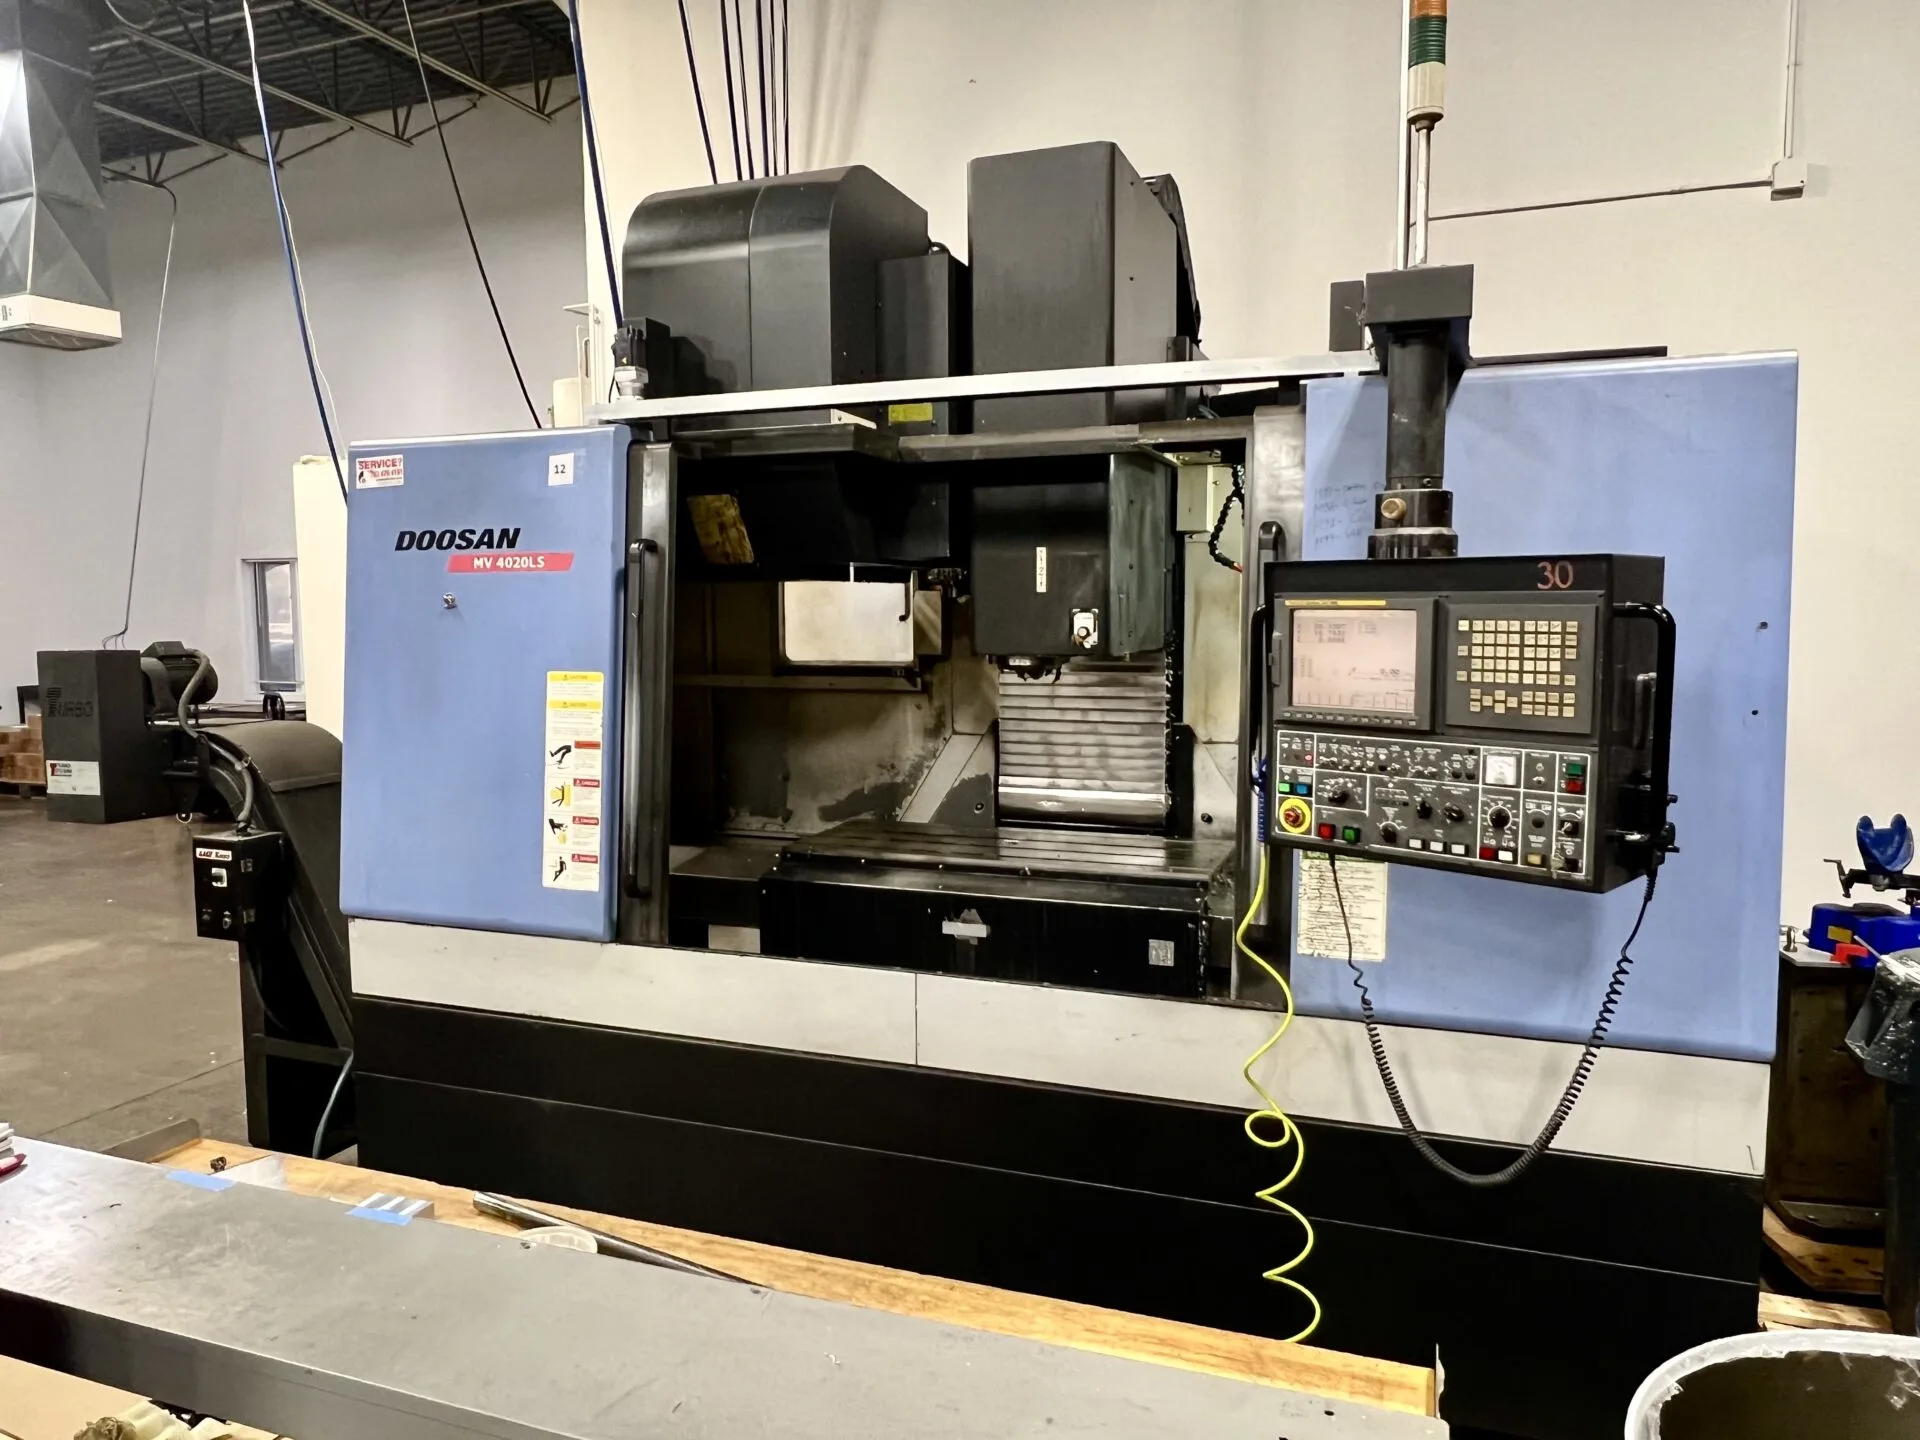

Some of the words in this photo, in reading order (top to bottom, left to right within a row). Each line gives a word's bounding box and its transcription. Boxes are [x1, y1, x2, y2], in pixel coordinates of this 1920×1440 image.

[554, 464, 566, 474] 12
[394, 528, 521, 551] DOOSAN
[473, 556, 492, 569] MV
[496, 555, 545, 569] 4020LS
[1537, 560, 1574, 589] 30
